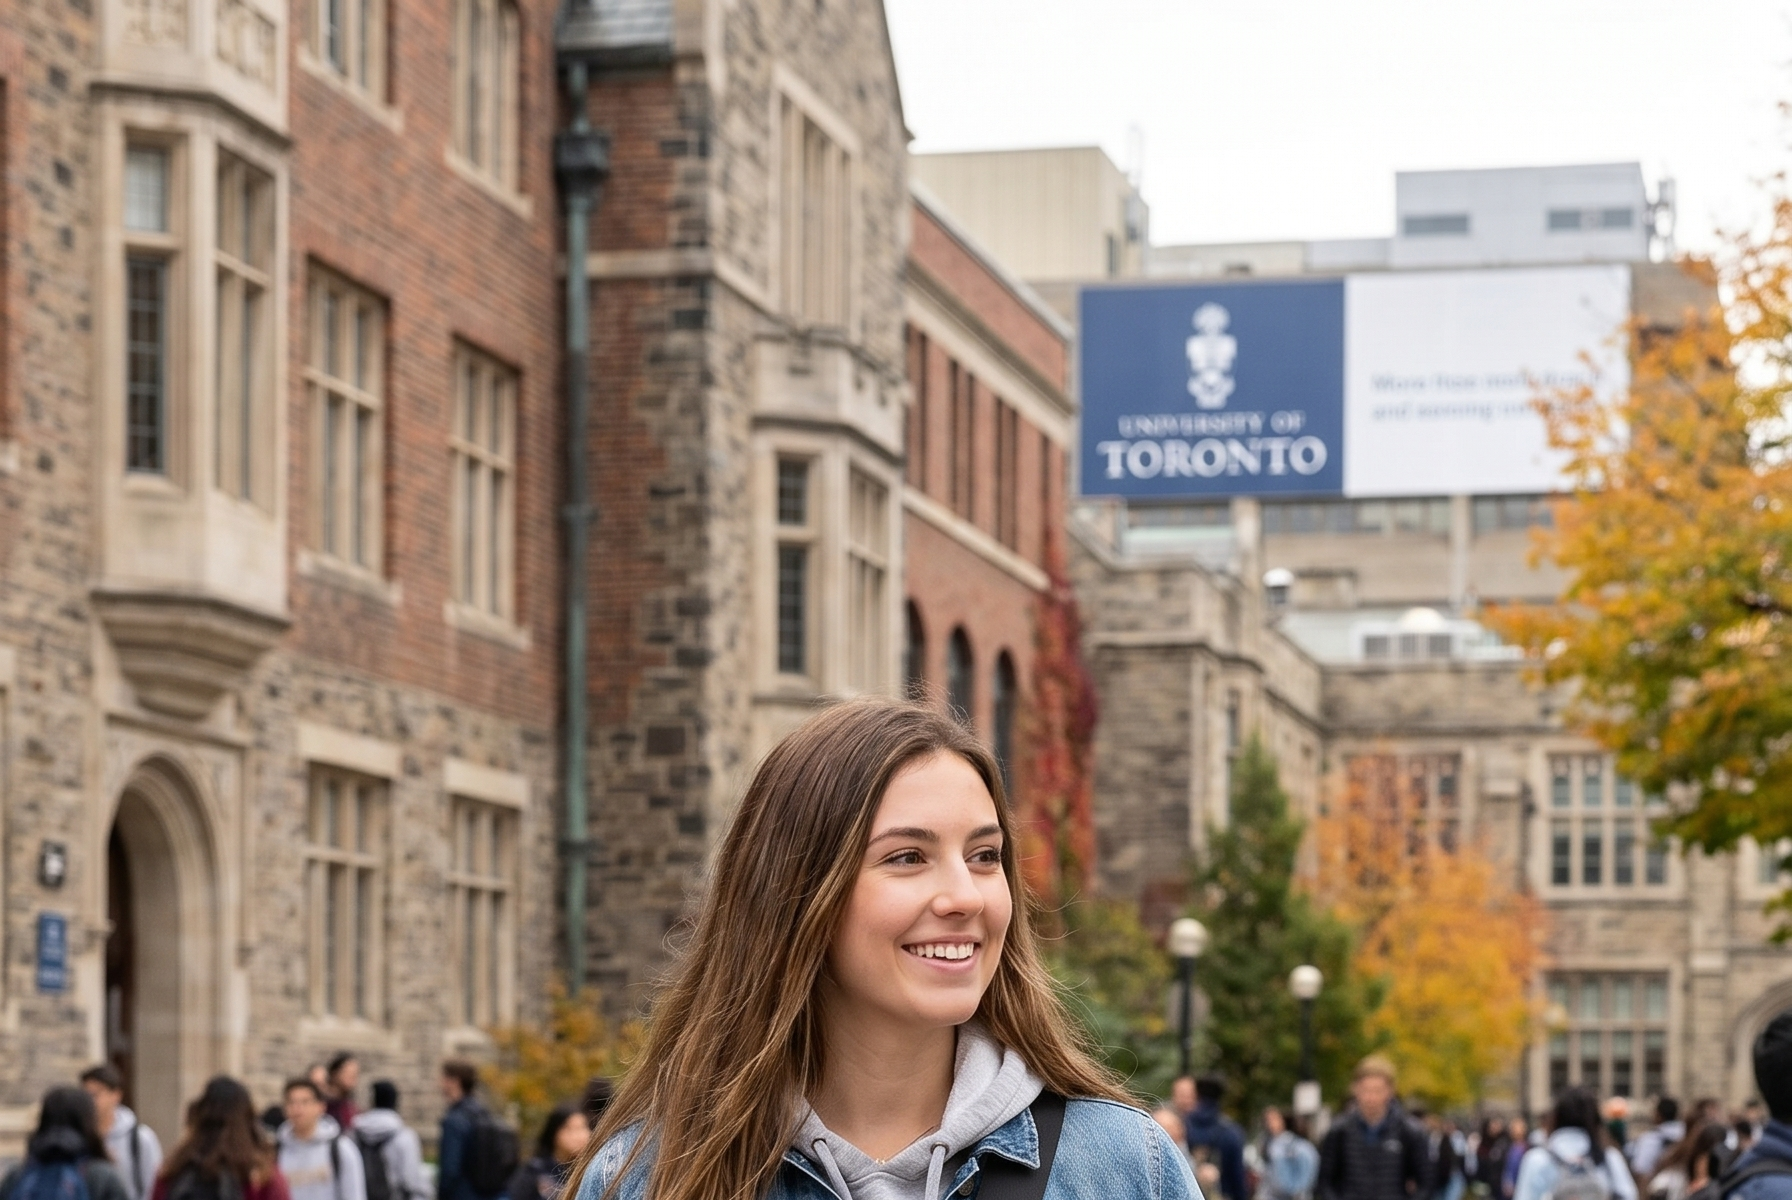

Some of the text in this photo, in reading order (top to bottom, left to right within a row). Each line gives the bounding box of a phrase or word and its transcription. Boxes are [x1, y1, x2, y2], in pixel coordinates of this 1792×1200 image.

[1118, 410, 1306, 437] UNIVERSITY OF
[1096, 436, 1328, 479] TORONTO
